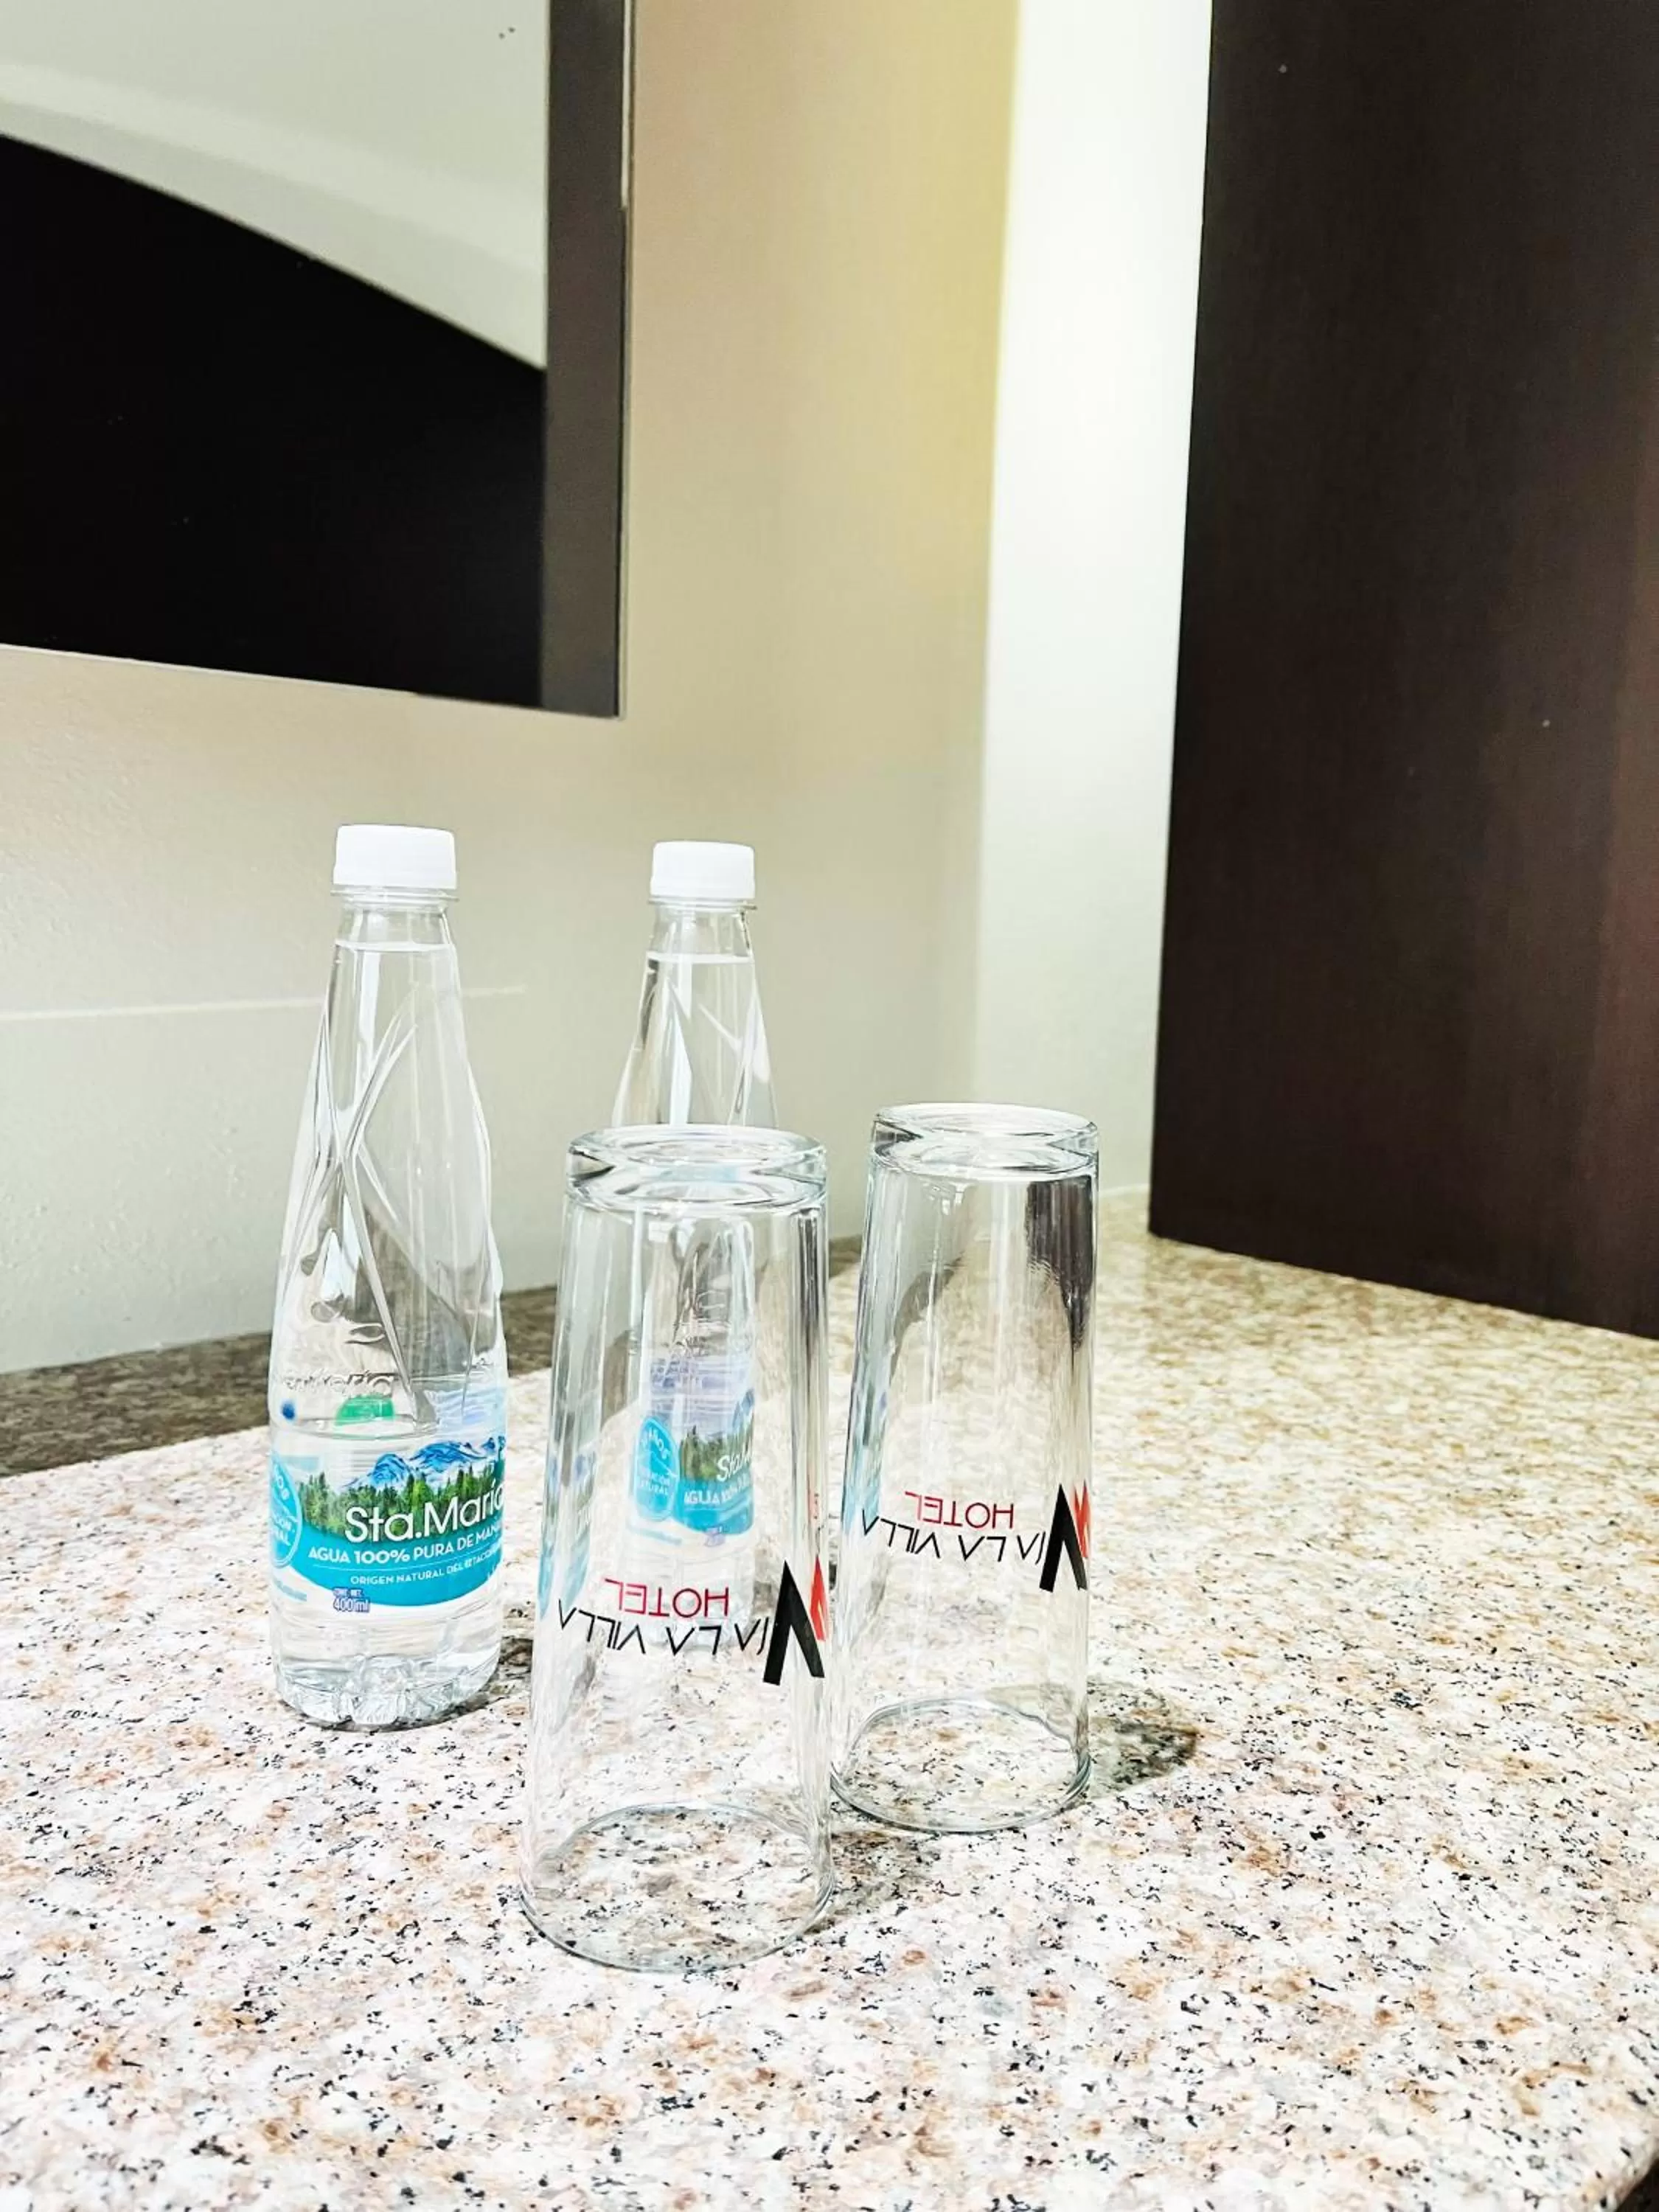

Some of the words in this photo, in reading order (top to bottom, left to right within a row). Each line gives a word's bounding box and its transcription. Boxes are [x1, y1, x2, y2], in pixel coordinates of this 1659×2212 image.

[905, 1490, 1014, 1529] HOTEL
[307, 1545, 350, 1563] AGUA
[353, 1547, 411, 1565] 100%
[413, 1540, 453, 1561] PURA
[456, 1537, 475, 1551] DE
[861, 1508, 941, 1559] VILLA
[958, 1534, 1007, 1562] LA
[350, 1575, 394, 1585] ORIGEN
[397, 1569, 445, 1583] NATURAL
[604, 1577, 730, 1618] HOTEL
[557, 1598, 647, 1655] VILLA
[666, 1625, 723, 1656] LA
